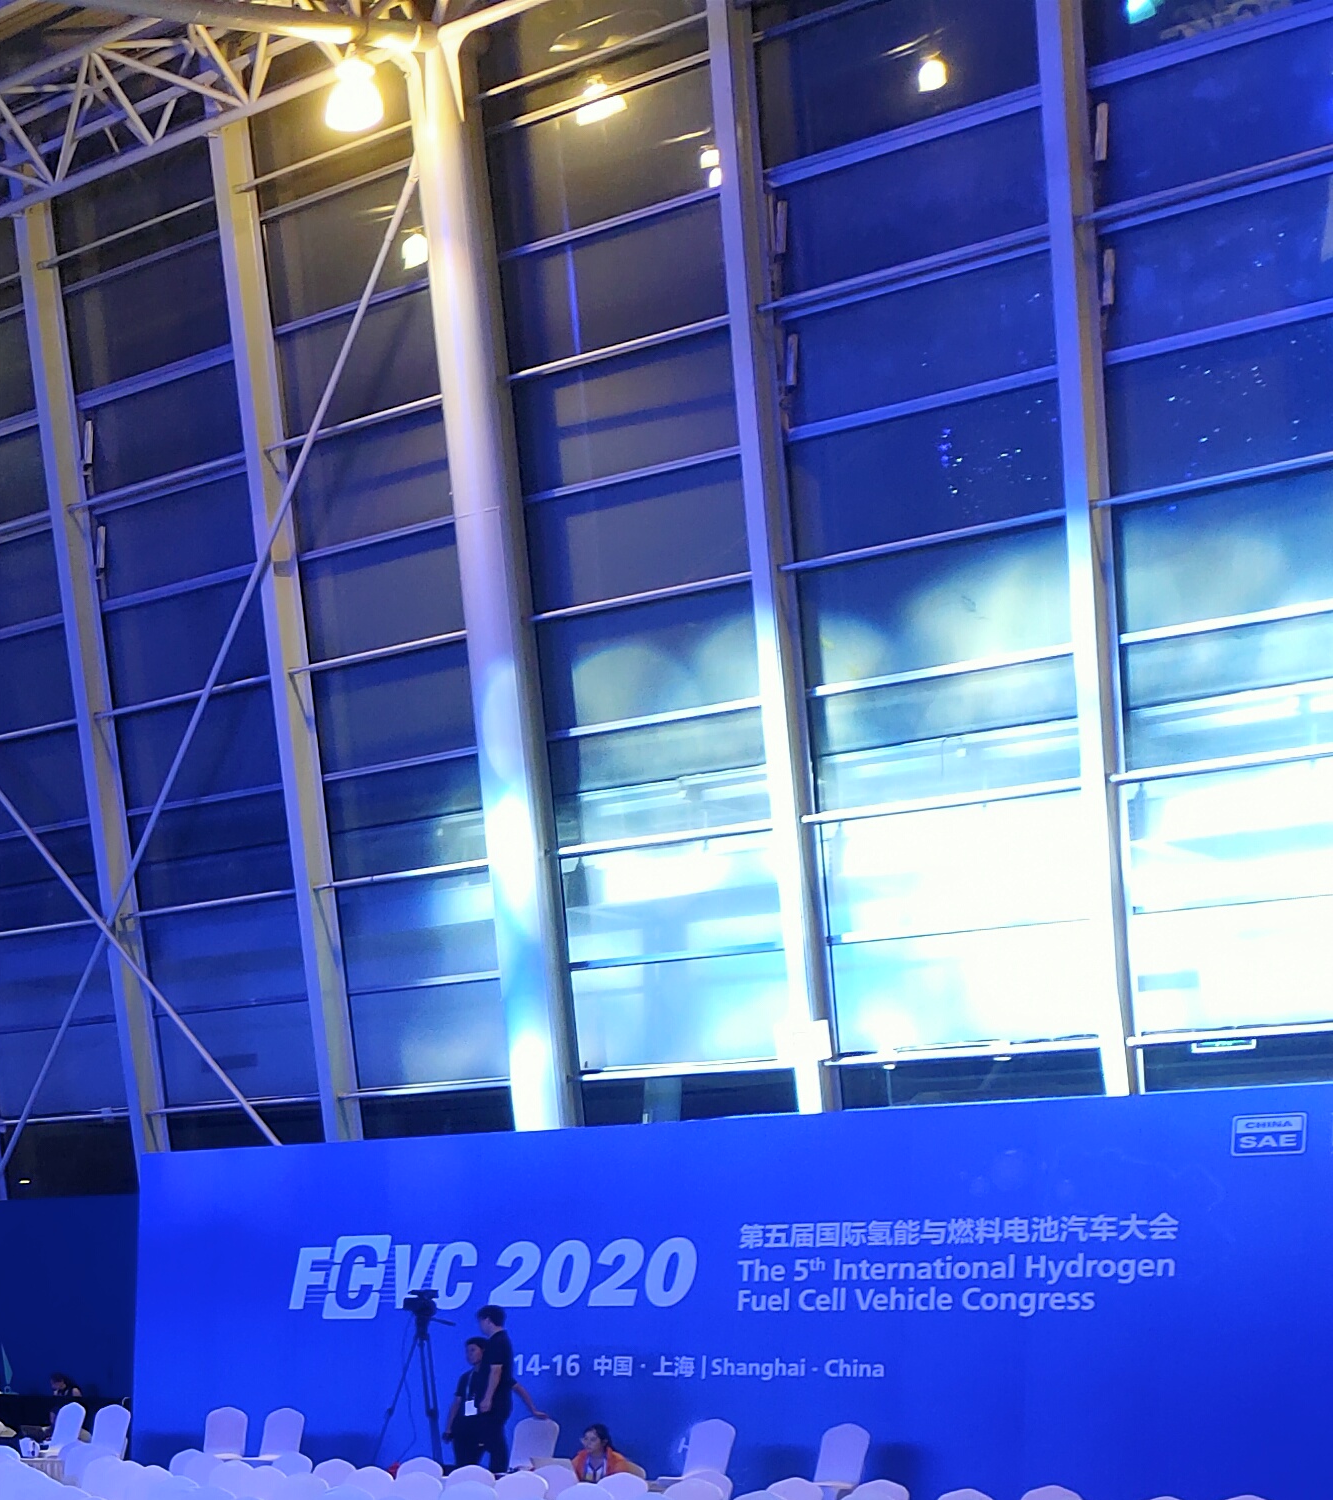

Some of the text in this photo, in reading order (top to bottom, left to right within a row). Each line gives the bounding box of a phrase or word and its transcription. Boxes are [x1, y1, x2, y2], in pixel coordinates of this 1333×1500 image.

[1244, 1120, 1293, 1129] CHINA
[1239, 1133, 1297, 1149] SAE
[738, 1212, 1179, 1250] 第五届国际氢能与燃料电池汽车大会
[289, 1234, 698, 1320] FCVC 2020
[737, 1252, 1176, 1285] The 5th International Hydrogen
[737, 1286, 1095, 1318] Fuel Cell Vehicle Congress
[710, 1356, 806, 1382] Shanghai
[824, 1358, 885, 1378] China
